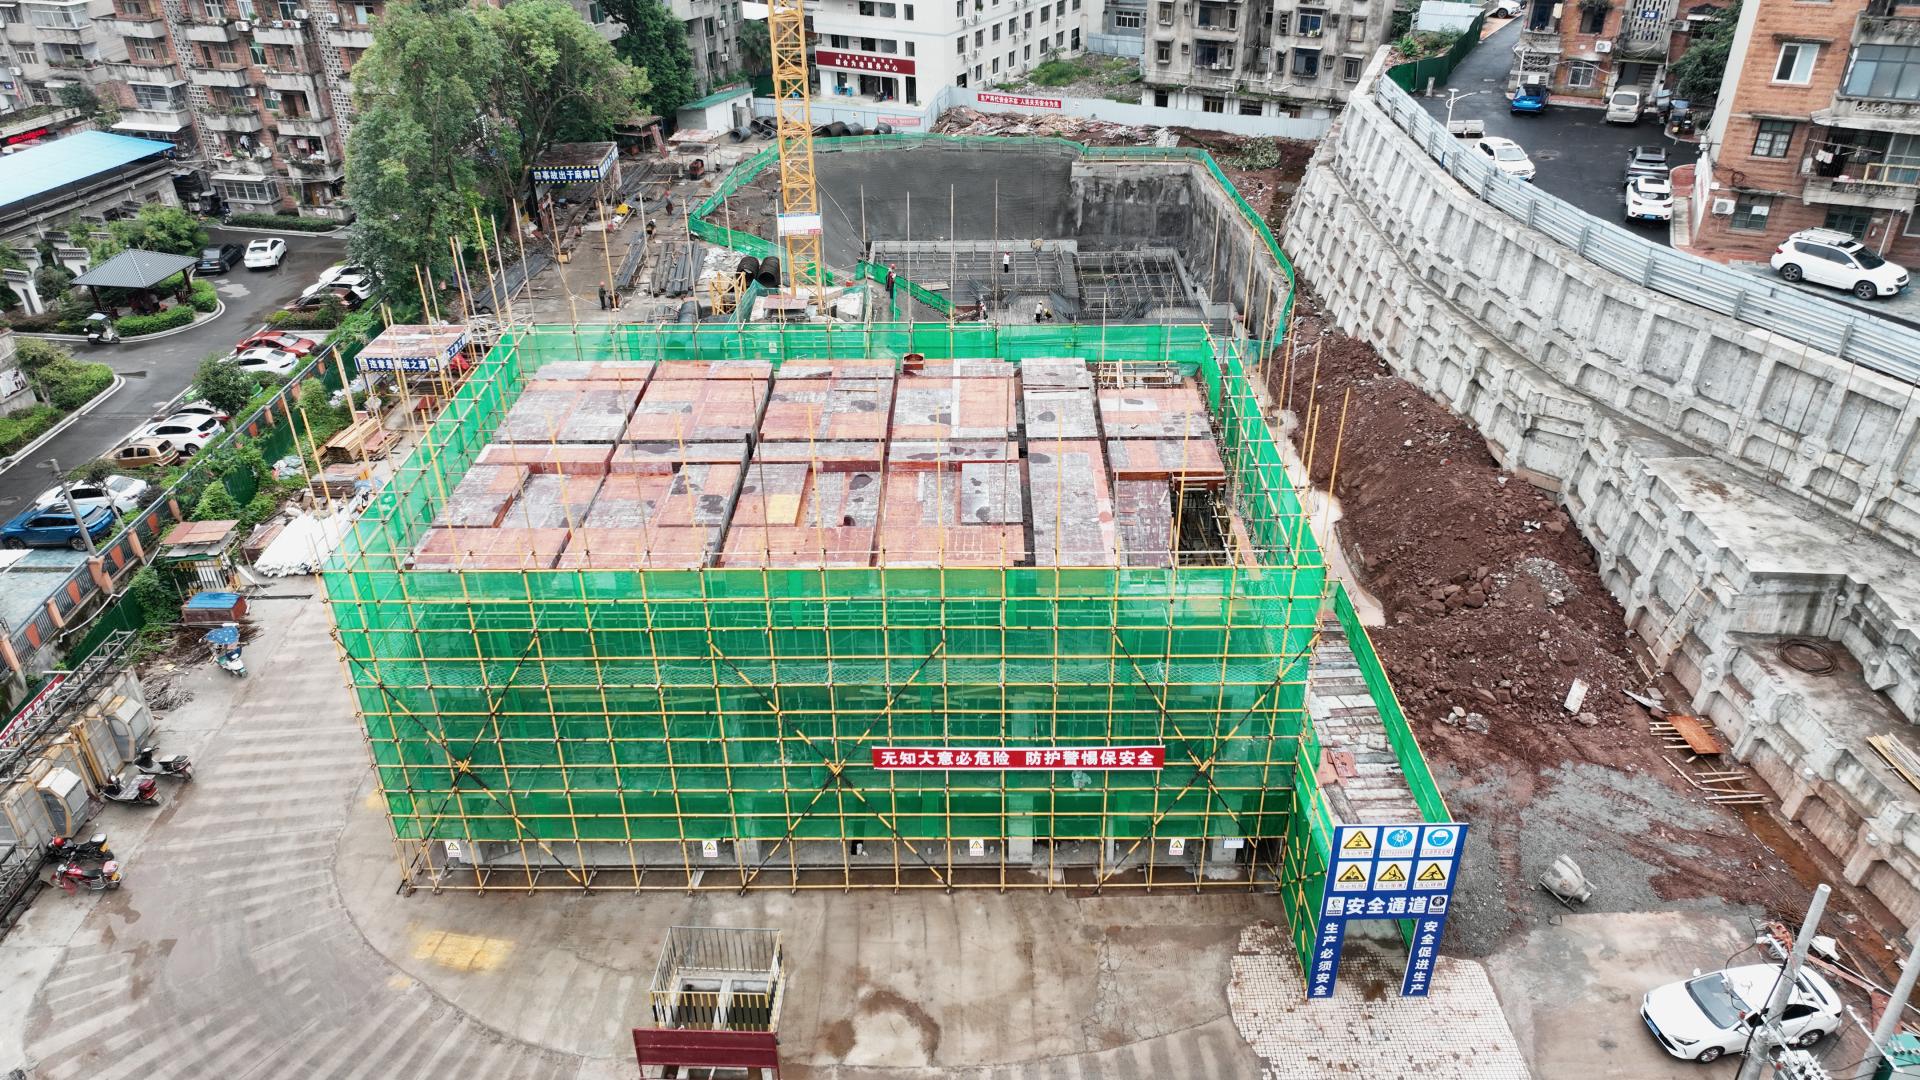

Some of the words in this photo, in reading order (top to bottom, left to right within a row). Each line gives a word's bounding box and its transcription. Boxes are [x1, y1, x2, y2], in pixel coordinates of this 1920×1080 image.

[369, 359, 428, 371] 违章是故之源
[881, 751, 1010, 766] 无知大意必危险
[1025, 750, 1155, 765] 防护警惕保安全
[1346, 896, 1428, 915] 安全通道
[1313, 922, 1339, 996] 生产必须安全
[1409, 920, 1438, 994] 安全促进生产
